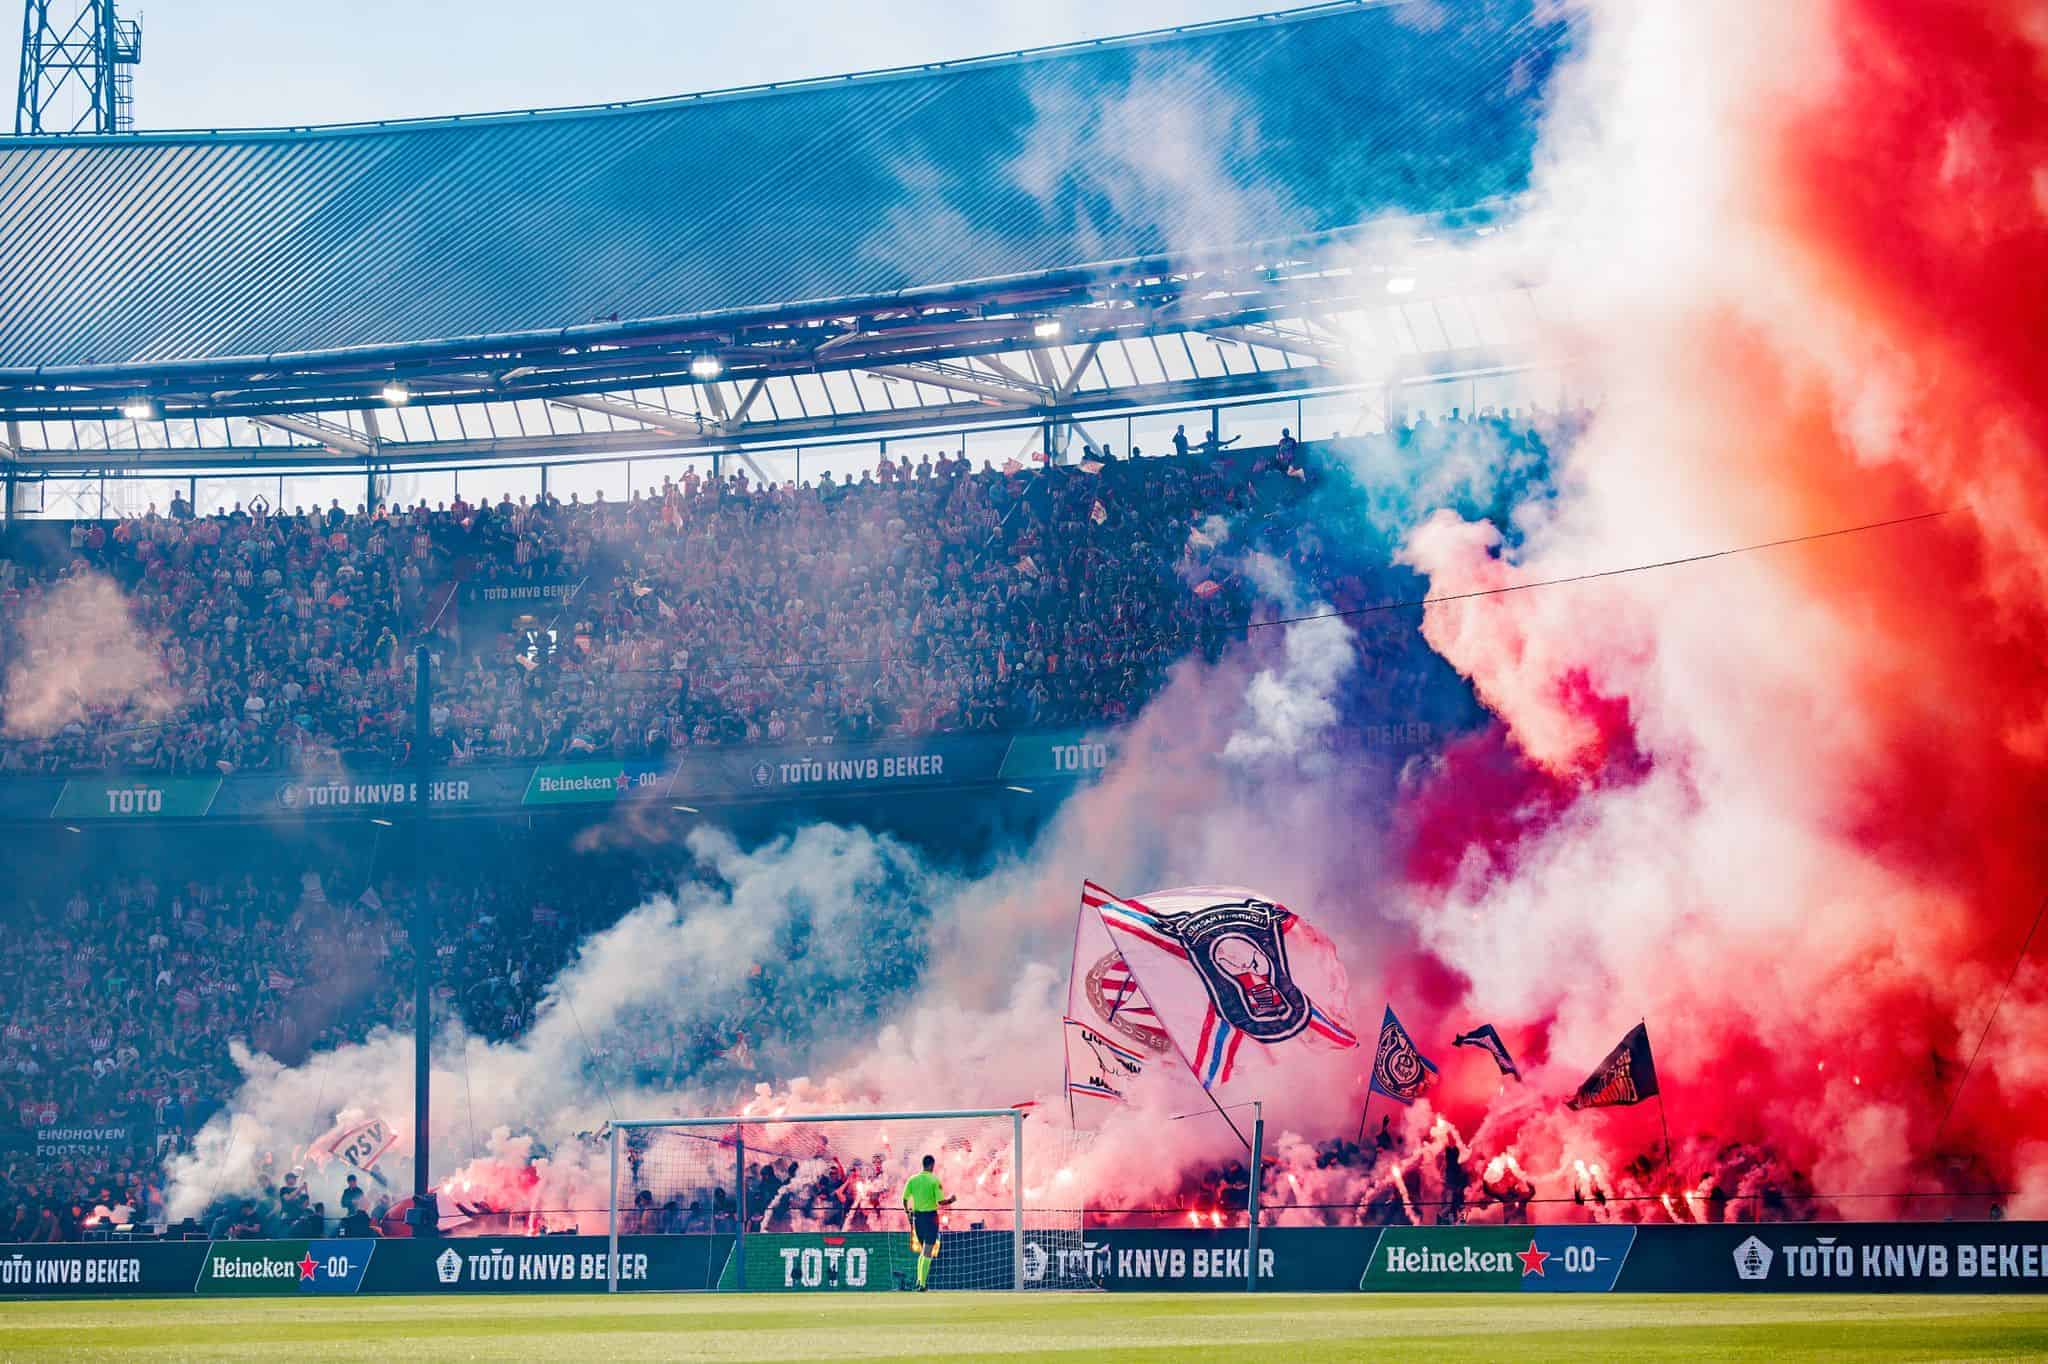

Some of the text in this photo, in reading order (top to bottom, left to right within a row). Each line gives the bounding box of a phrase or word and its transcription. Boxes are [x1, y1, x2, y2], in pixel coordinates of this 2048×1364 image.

[780, 754, 944, 784] TOTO KNVB BEKER
[1051, 744, 1106, 771] TOTO
[307, 780, 470, 806] TOTO KNVB BKER
[539, 776, 612, 792] Heineken
[106, 789, 162, 813] TOTO
[37, 1128, 125, 1140] EINDHOVEN
[36, 1144, 110, 1157] FOOT
[35, 1259, 81, 1283] KNVB
[85, 1259, 140, 1283] BEKER
[212, 1256, 295, 1278] Heineken
[468, 1254, 514, 1280] TOTO
[519, 1254, 576, 1280] KNVB
[780, 1247, 868, 1287] TOTO
[1118, 1249, 1186, 1278] KNVB
[1386, 1246, 1514, 1273] Heineken
[1781, 1245, 1854, 1277] TOTO
[1862, 1244, 1949, 1277] KNVB
